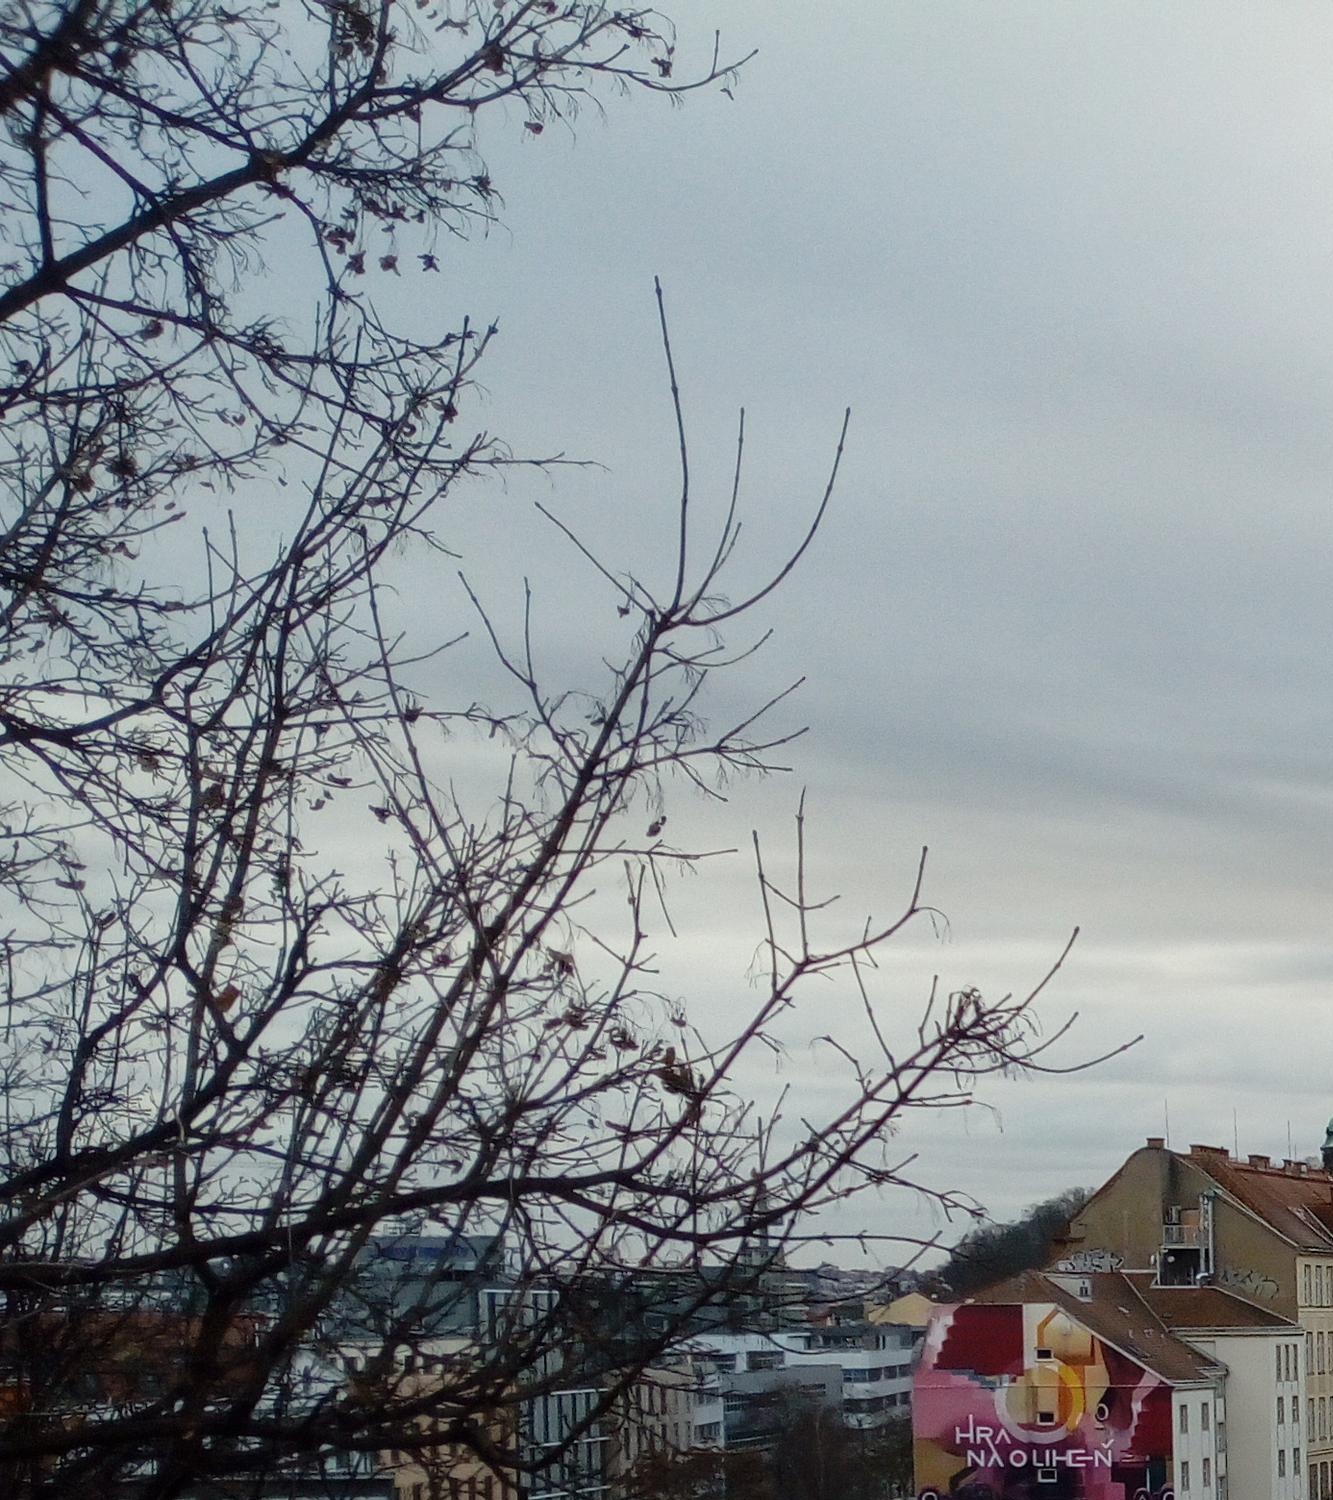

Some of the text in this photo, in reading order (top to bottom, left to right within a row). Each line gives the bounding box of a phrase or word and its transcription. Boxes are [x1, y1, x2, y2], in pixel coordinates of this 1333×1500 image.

[955, 1413, 1012, 1445] HRA
[967, 1438, 1114, 1468] NA OLIHEŇ
